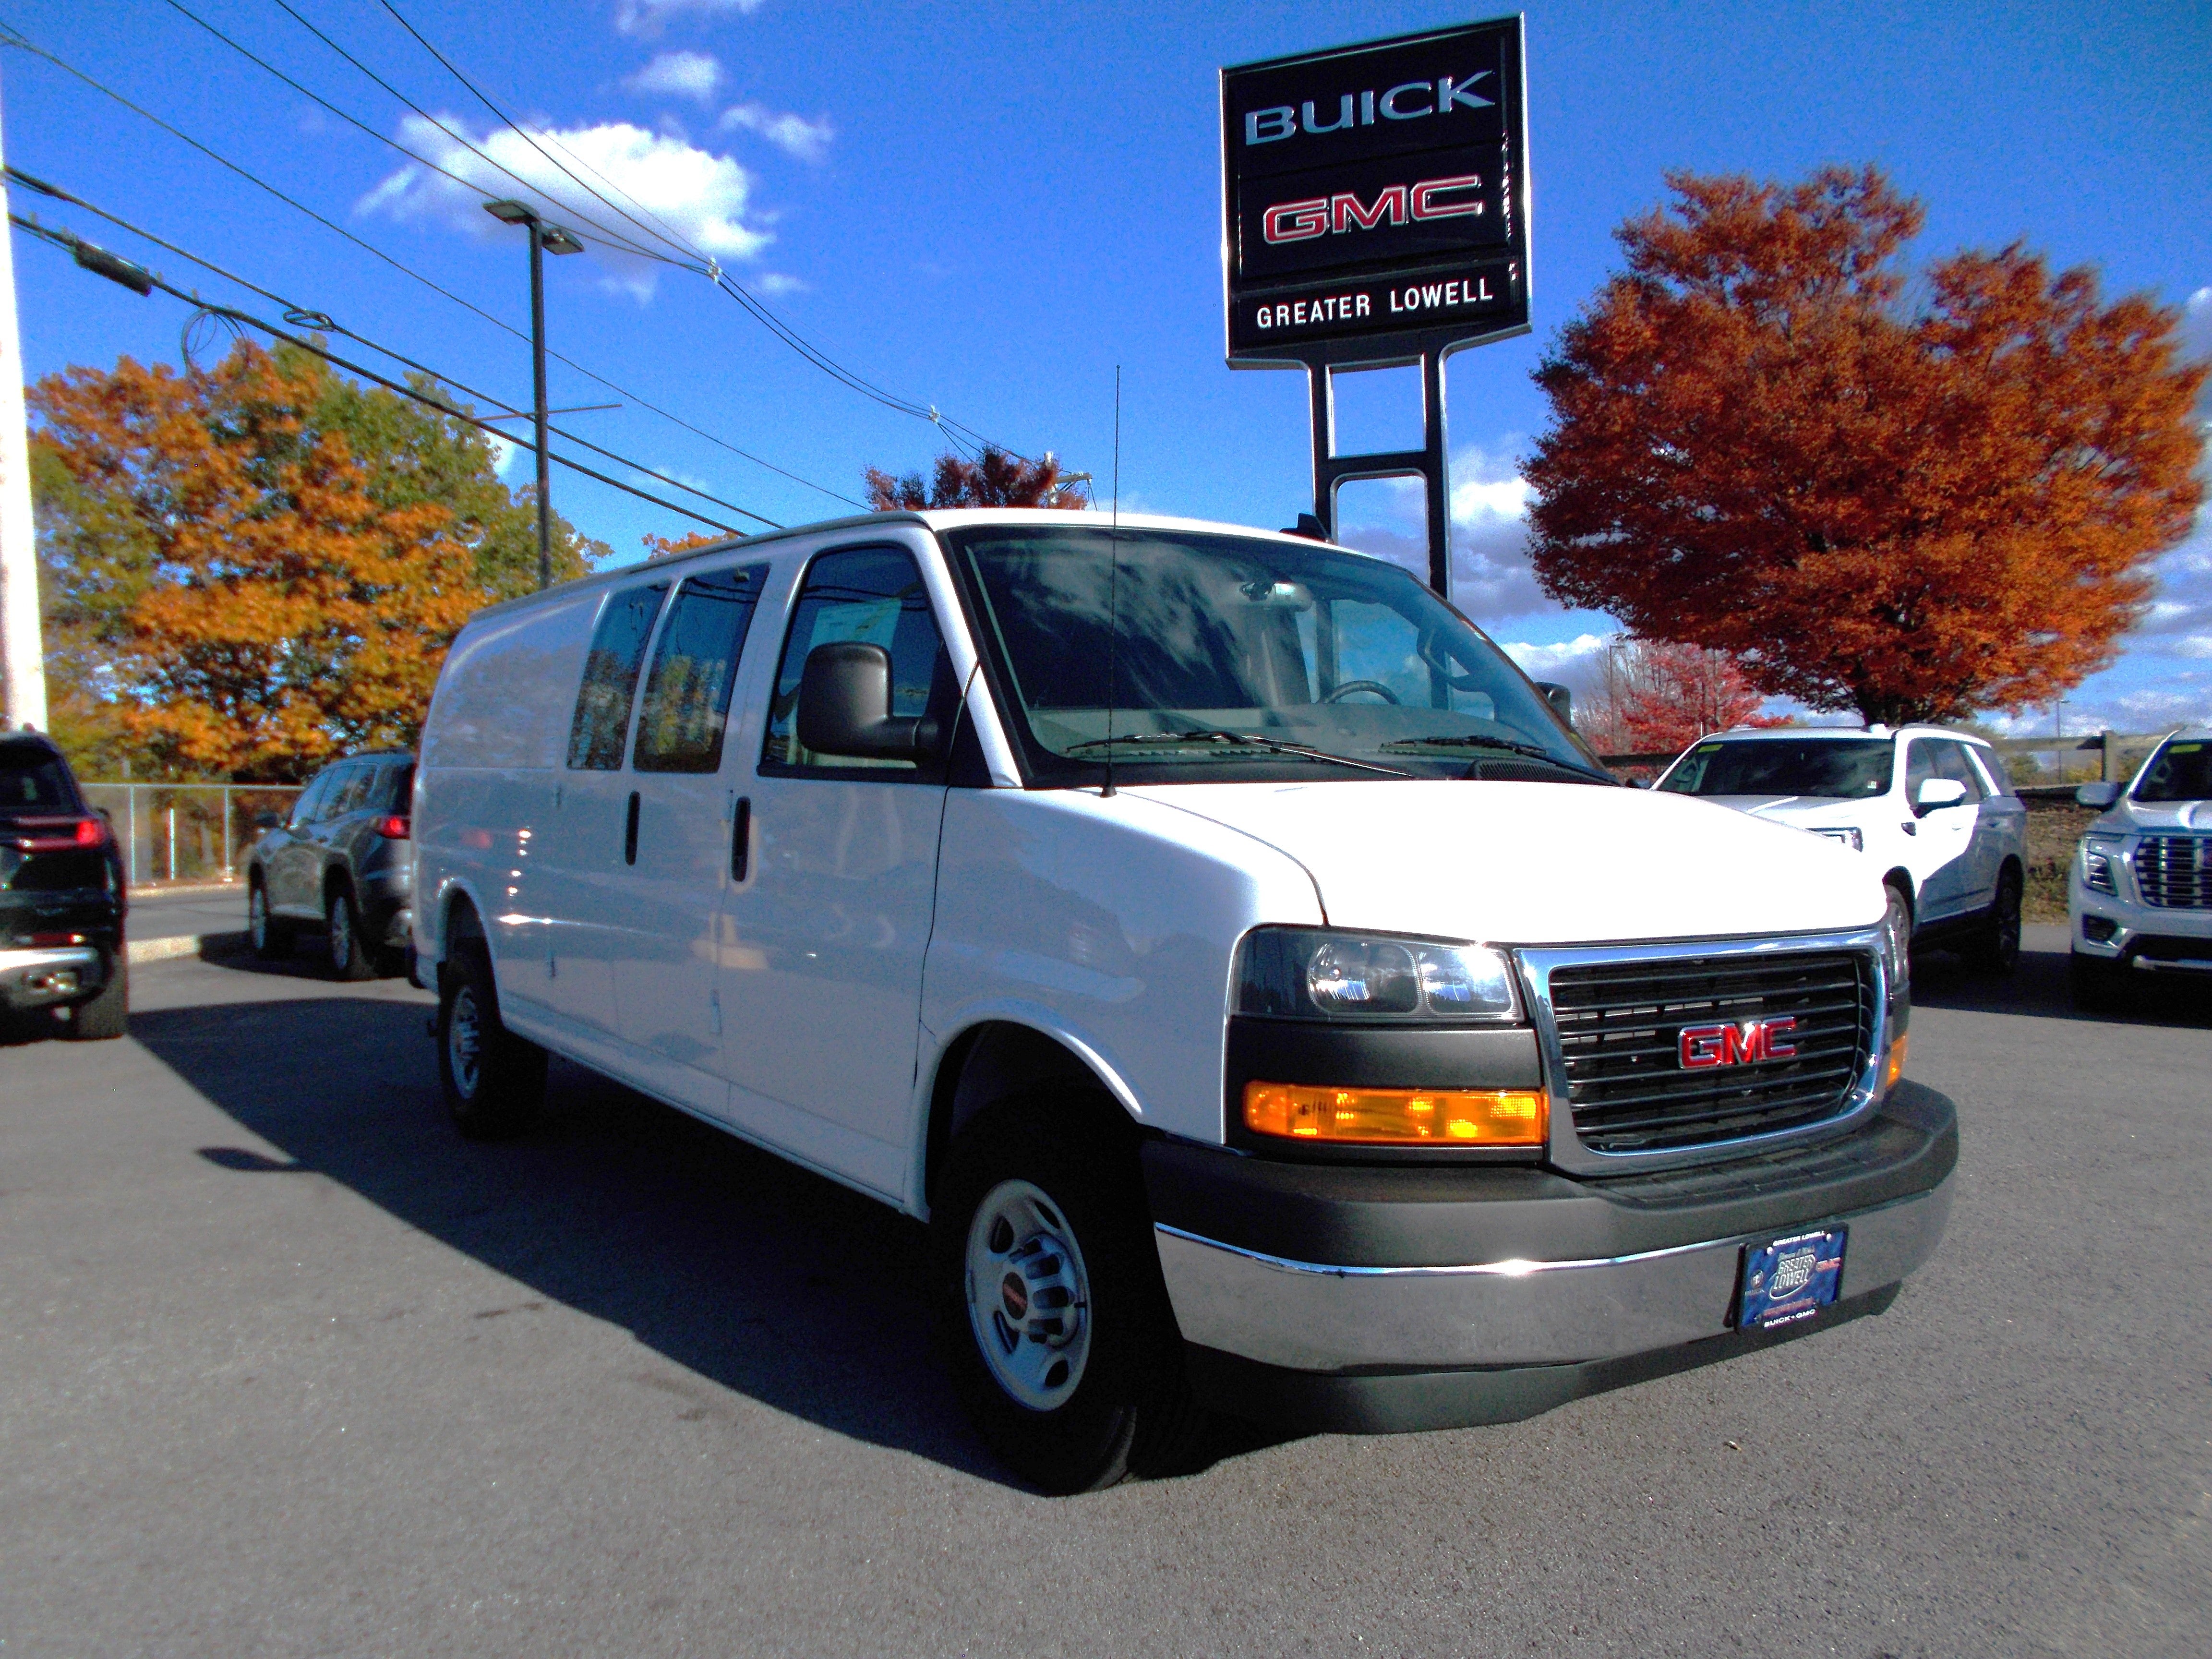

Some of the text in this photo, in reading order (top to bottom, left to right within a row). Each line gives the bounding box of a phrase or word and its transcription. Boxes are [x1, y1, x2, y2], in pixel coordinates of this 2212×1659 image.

[1245, 70, 1495, 145] BUICK
[1263, 175, 1483, 244] GMC
[1257, 277, 1493, 329] GREATER LOWELL
[1678, 1016, 1797, 1070] GMC
[1774, 1268, 1810, 1290] LOWELL
